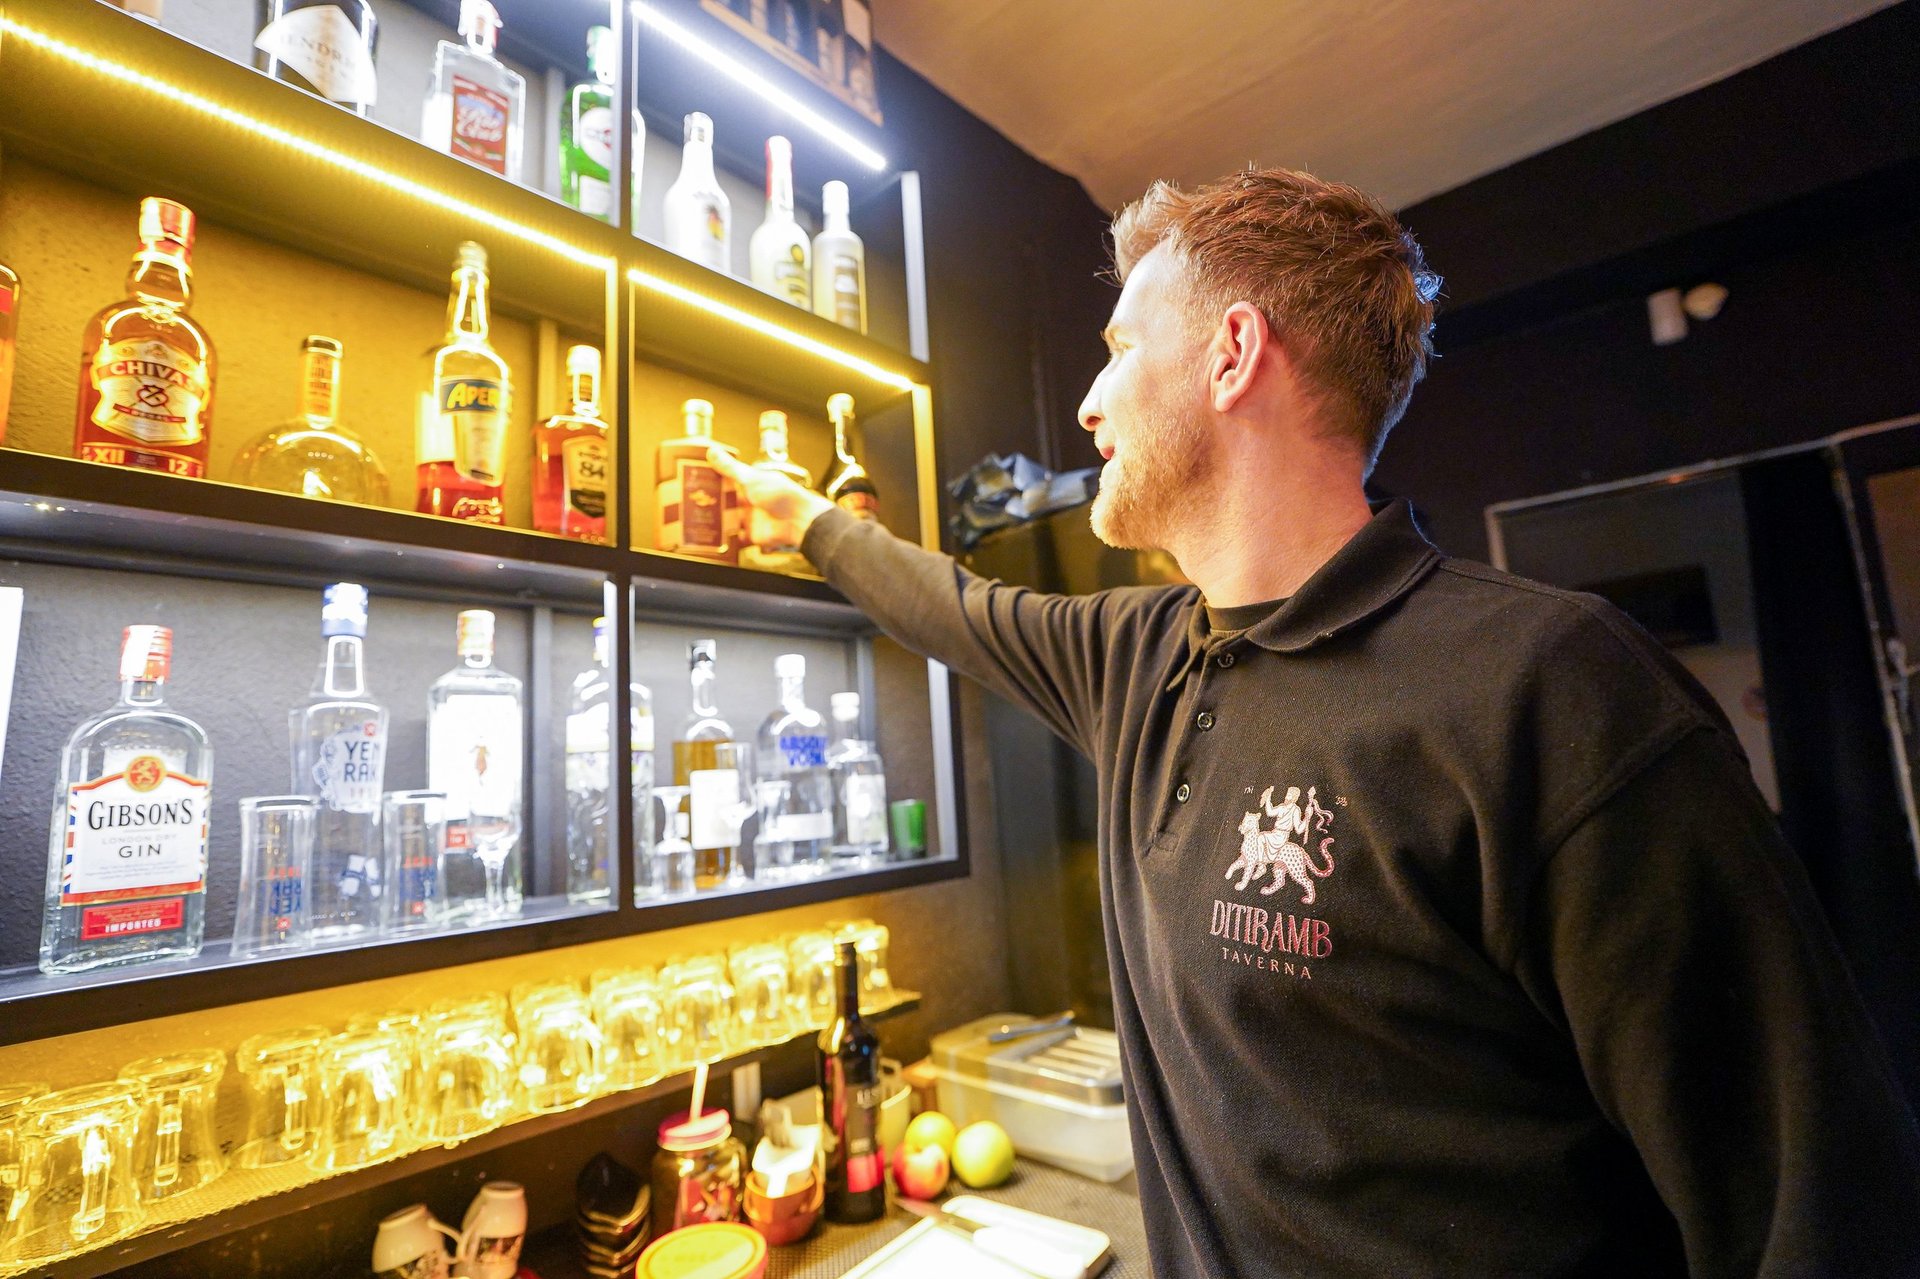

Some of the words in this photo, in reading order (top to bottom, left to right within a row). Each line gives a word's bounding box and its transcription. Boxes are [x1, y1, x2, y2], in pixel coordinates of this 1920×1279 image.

[446, 382, 509, 410] APER
[94, 448, 125, 464] XII
[168, 458, 188, 475] 12
[118, 844, 161, 858] GIN
[105, 918, 161, 933] IMPORTED
[1209, 899, 1333, 959] DITIRAMB
[1222, 946, 1312, 980] TAVERNA
